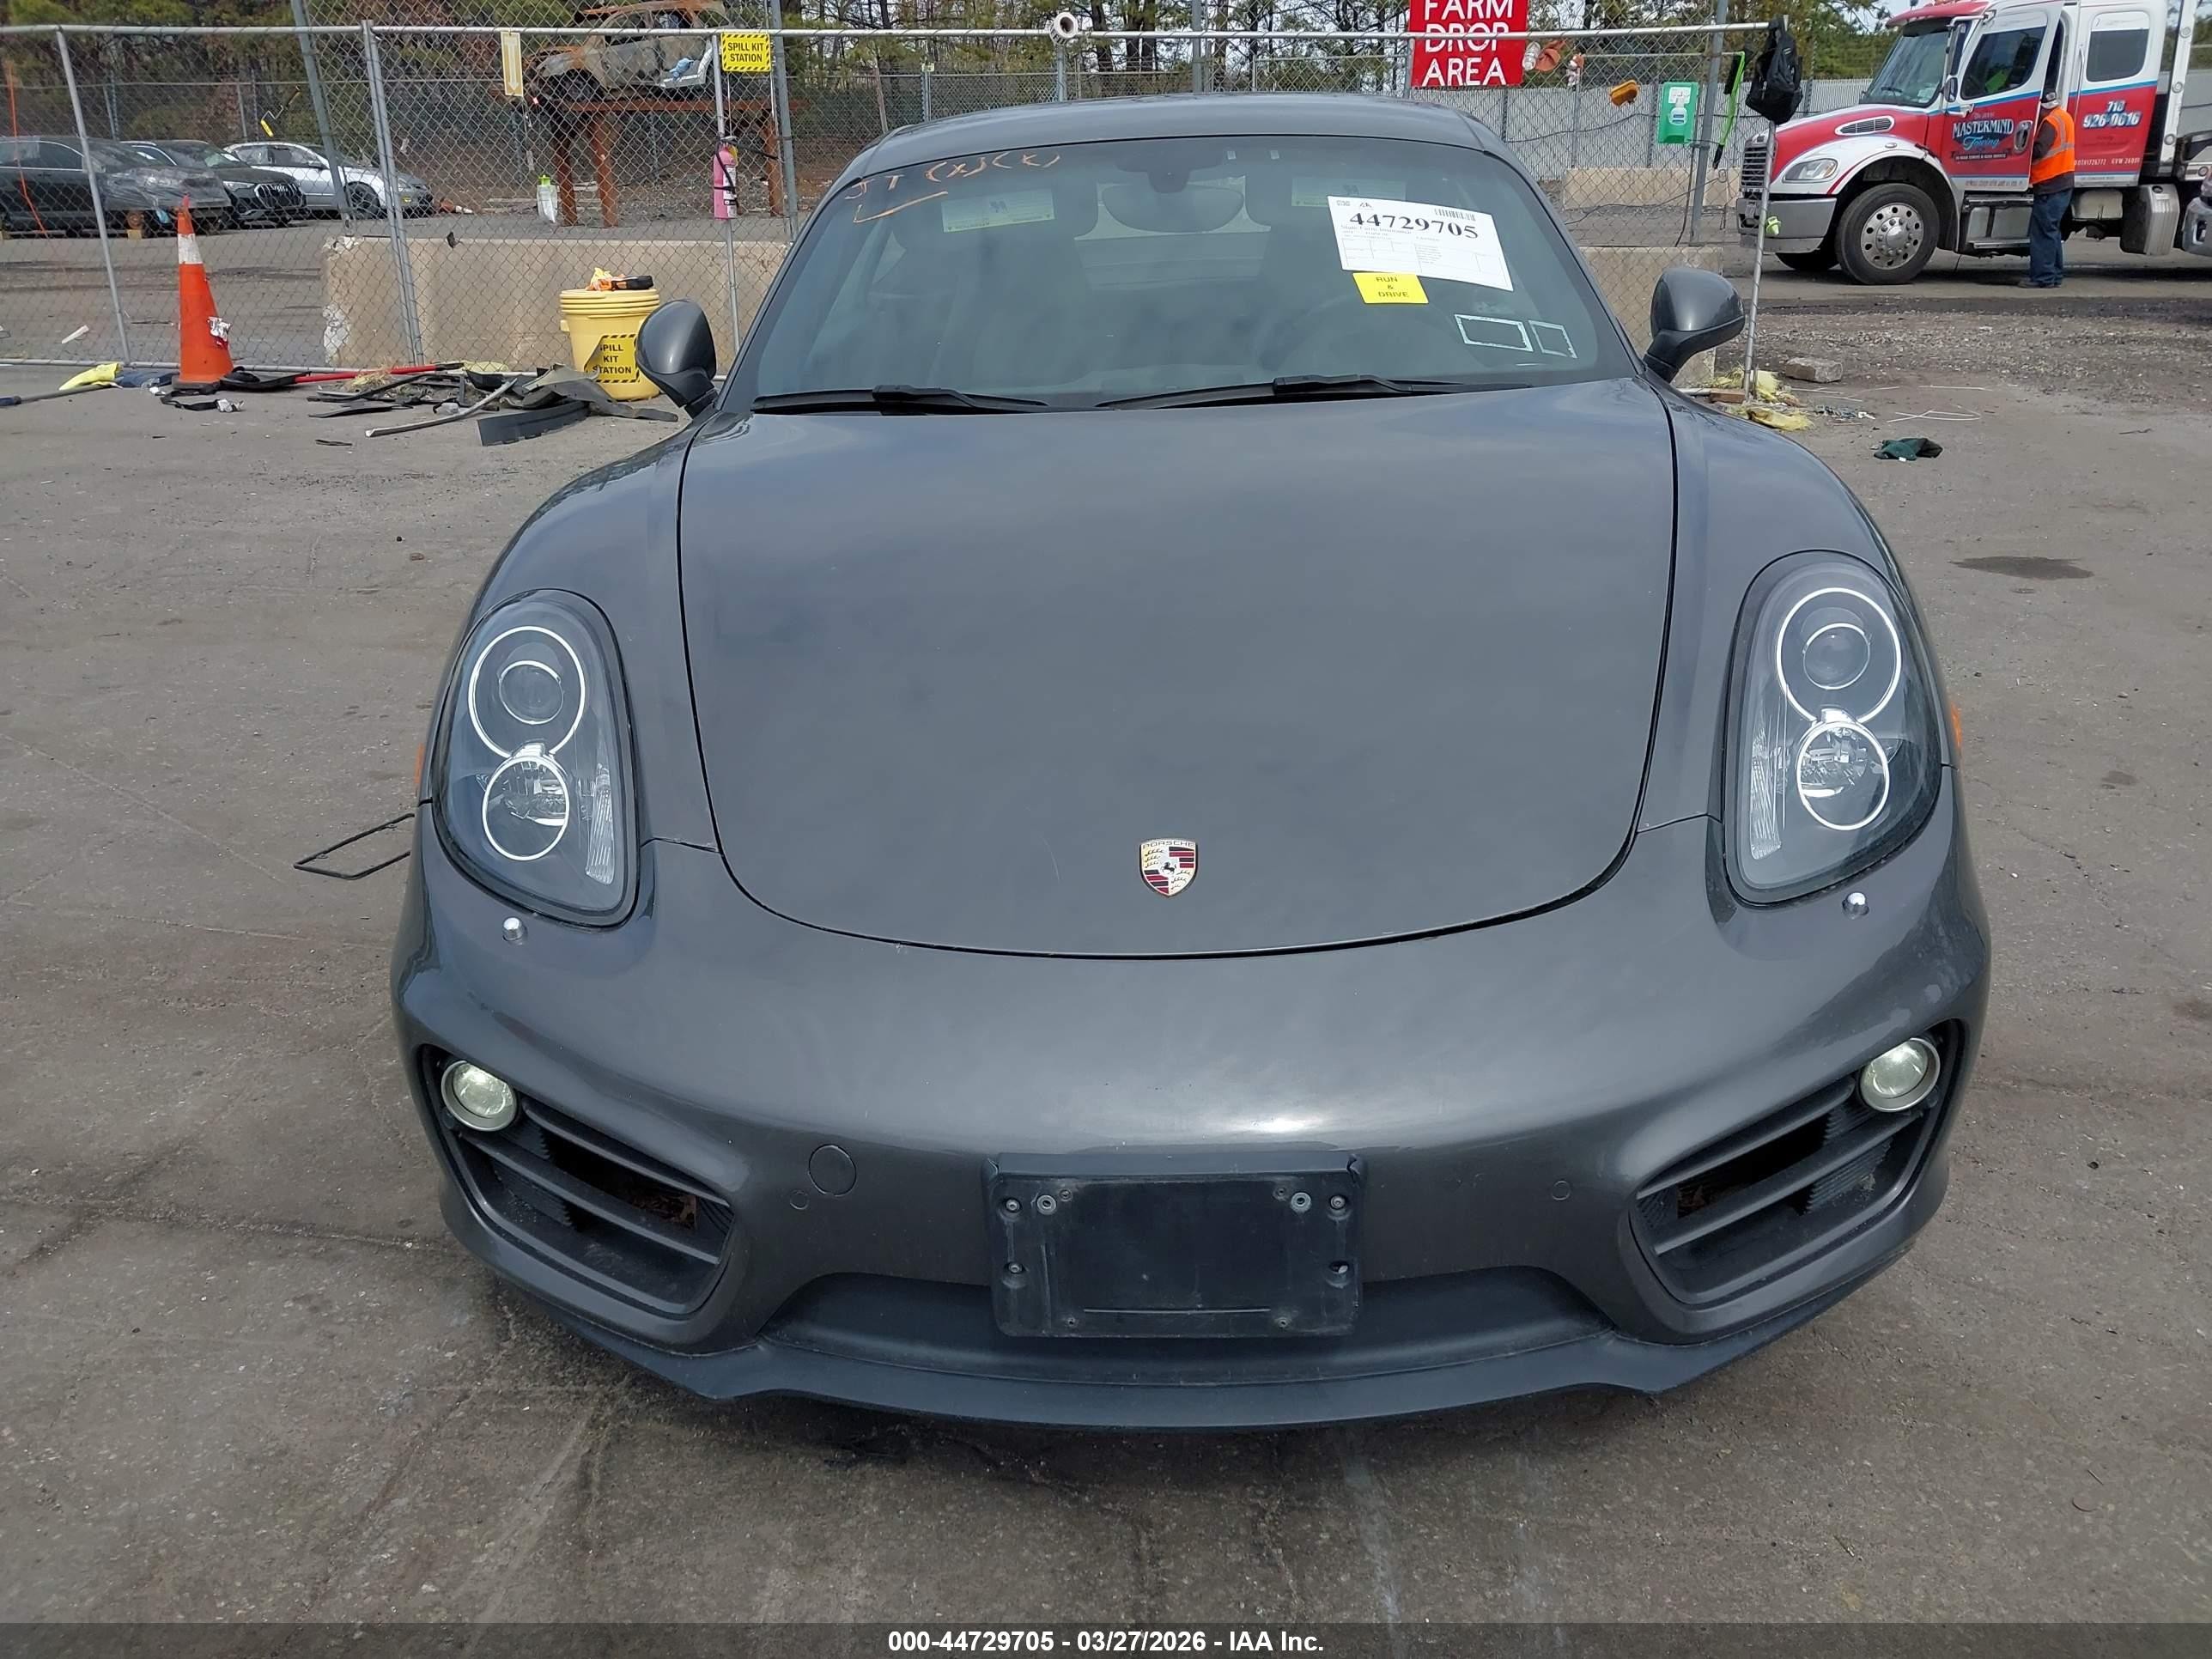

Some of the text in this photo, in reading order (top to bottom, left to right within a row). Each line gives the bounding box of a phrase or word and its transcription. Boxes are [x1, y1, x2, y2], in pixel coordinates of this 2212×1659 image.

[1424, 0, 1513, 21] FARM
[1425, 21, 1510, 52] DROP
[727, 42, 764, 52] SPILL KIT
[730, 53, 763, 63] STATION
[1421, 57, 1507, 86] AREA
[1953, 118, 2014, 137] MASTERMIND
[1963, 136, 1999, 150] Towing
[1349, 212, 1478, 239] 44729705
[1143, 840, 1195, 849] PORSCHE
